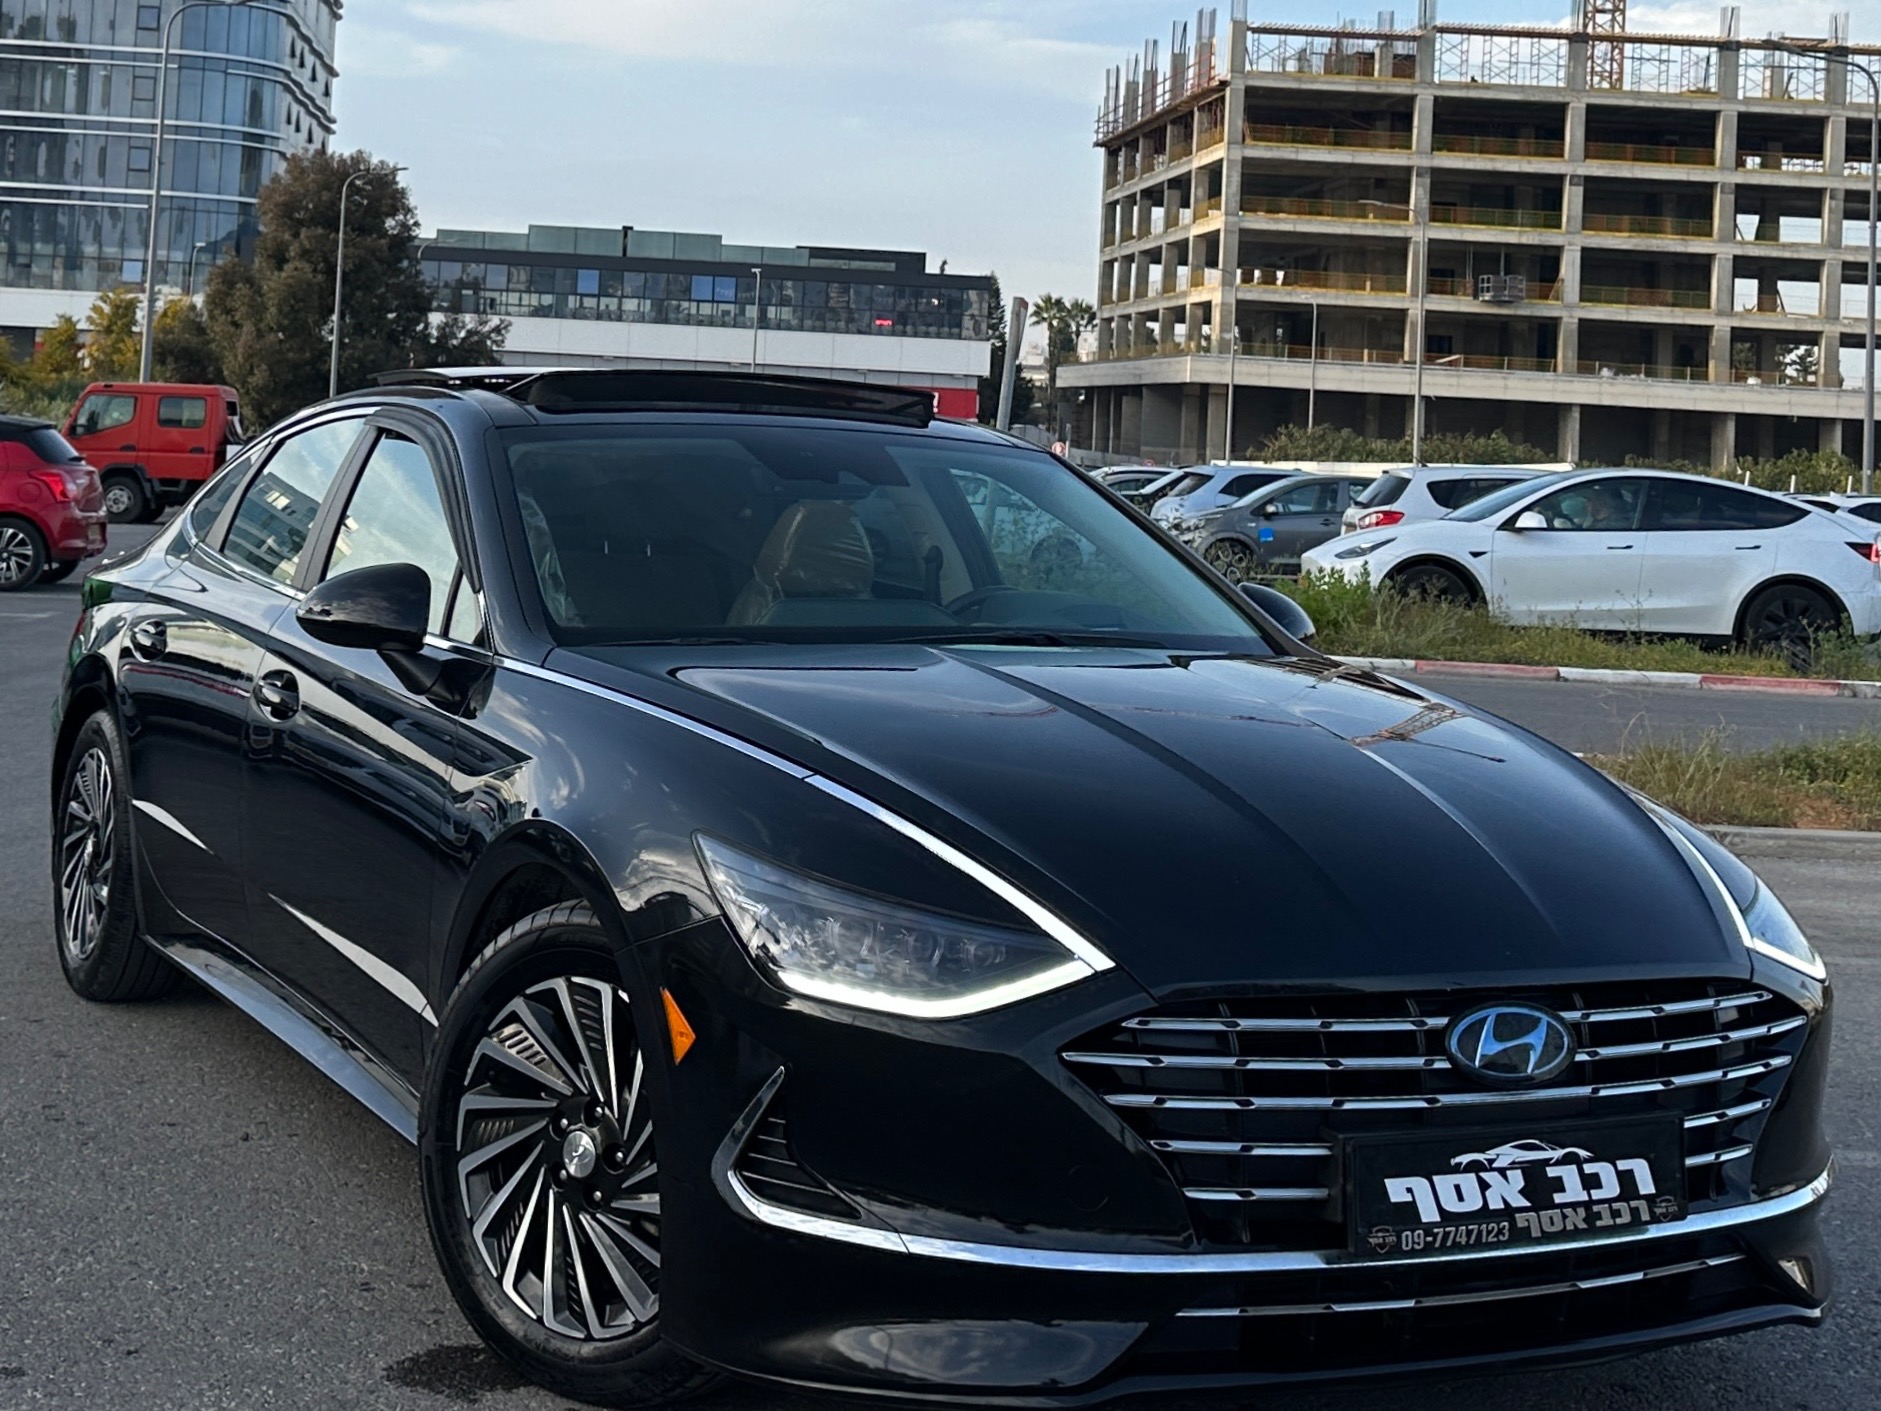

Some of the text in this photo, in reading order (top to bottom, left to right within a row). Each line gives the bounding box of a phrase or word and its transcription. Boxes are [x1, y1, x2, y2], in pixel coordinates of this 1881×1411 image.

[1383, 1159, 1657, 1223] רכב אסף
[1401, 1221, 1510, 1251] 09-7747123
[1514, 1199, 1651, 1237] רכב אסף
